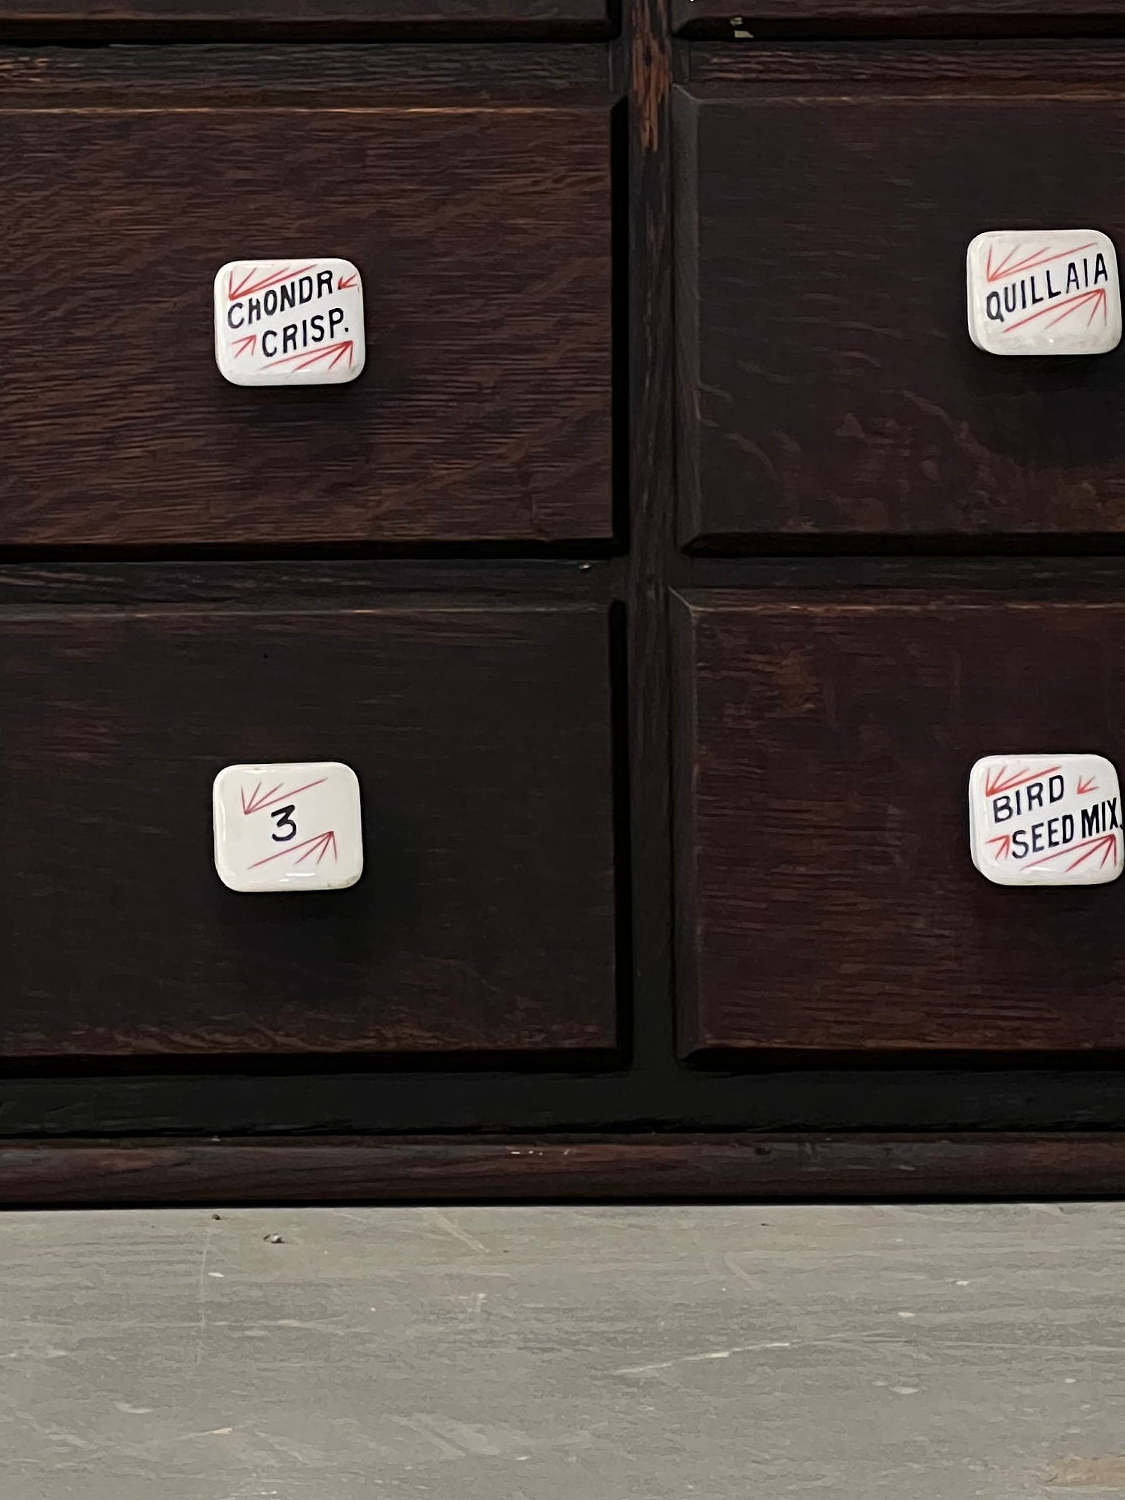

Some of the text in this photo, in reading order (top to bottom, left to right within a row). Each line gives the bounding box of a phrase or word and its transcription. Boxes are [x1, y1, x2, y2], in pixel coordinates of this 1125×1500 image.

[985, 253, 1109, 322] QUILLAIA
[261, 307, 350, 358] CRISP.
[270, 805, 298, 842] 3
[992, 775, 1065, 825] BIRD
[1011, 808, 1075, 859] SEED
